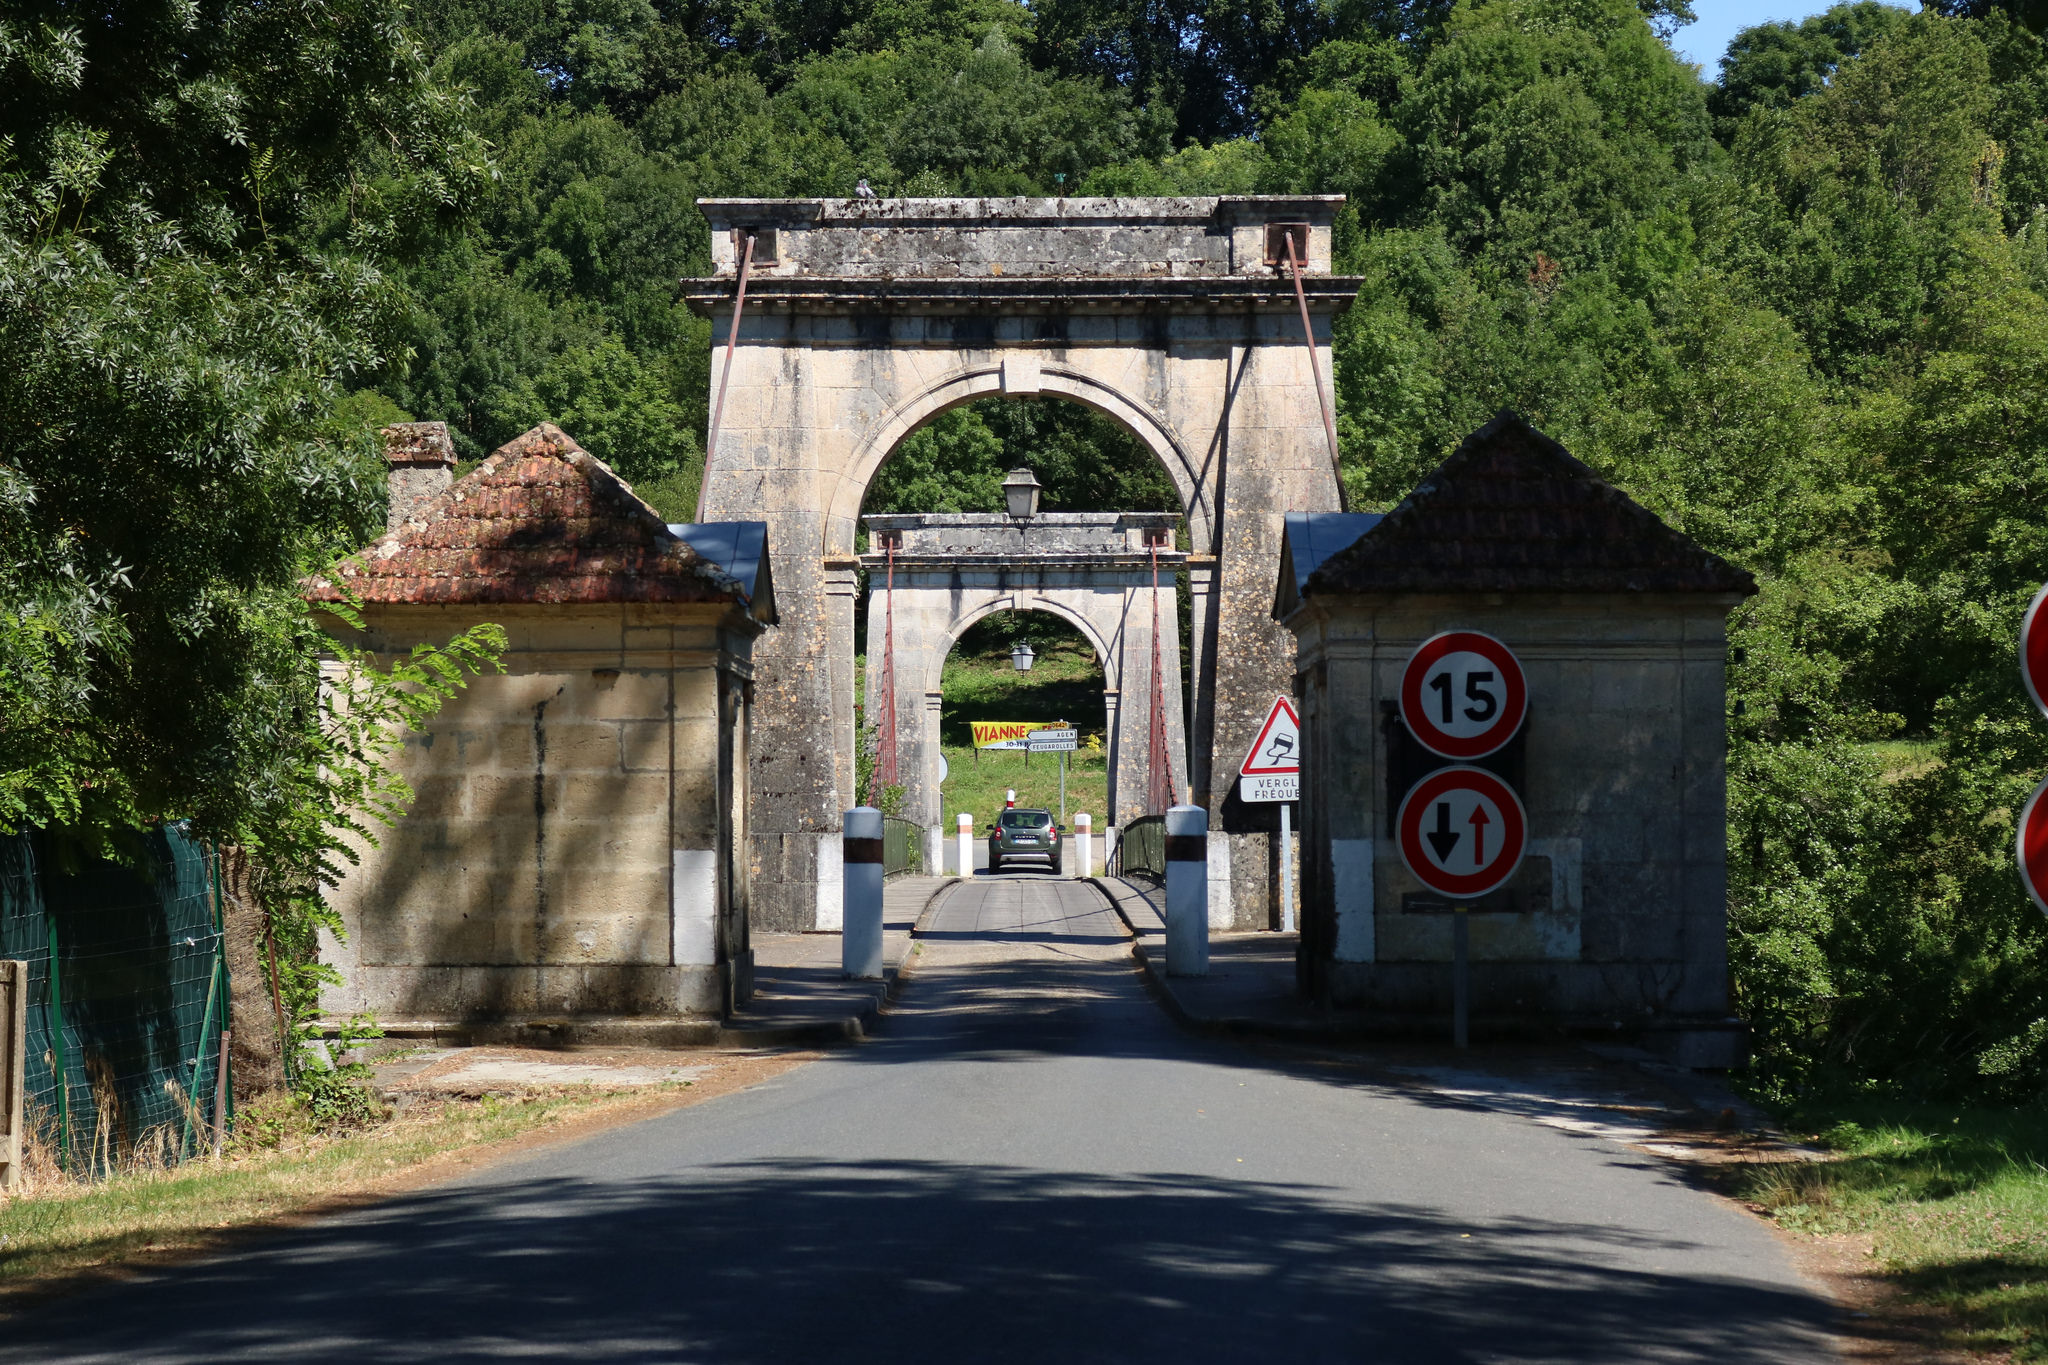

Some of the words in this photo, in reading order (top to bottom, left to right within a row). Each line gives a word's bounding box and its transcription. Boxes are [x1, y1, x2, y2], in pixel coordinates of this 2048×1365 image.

[1429, 671, 1497, 724] 15
[974, 725, 1026, 743] VIANNE
[1258, 778, 1298, 788] VERGL
[1254, 788, 1300, 799] FRÉQUE
